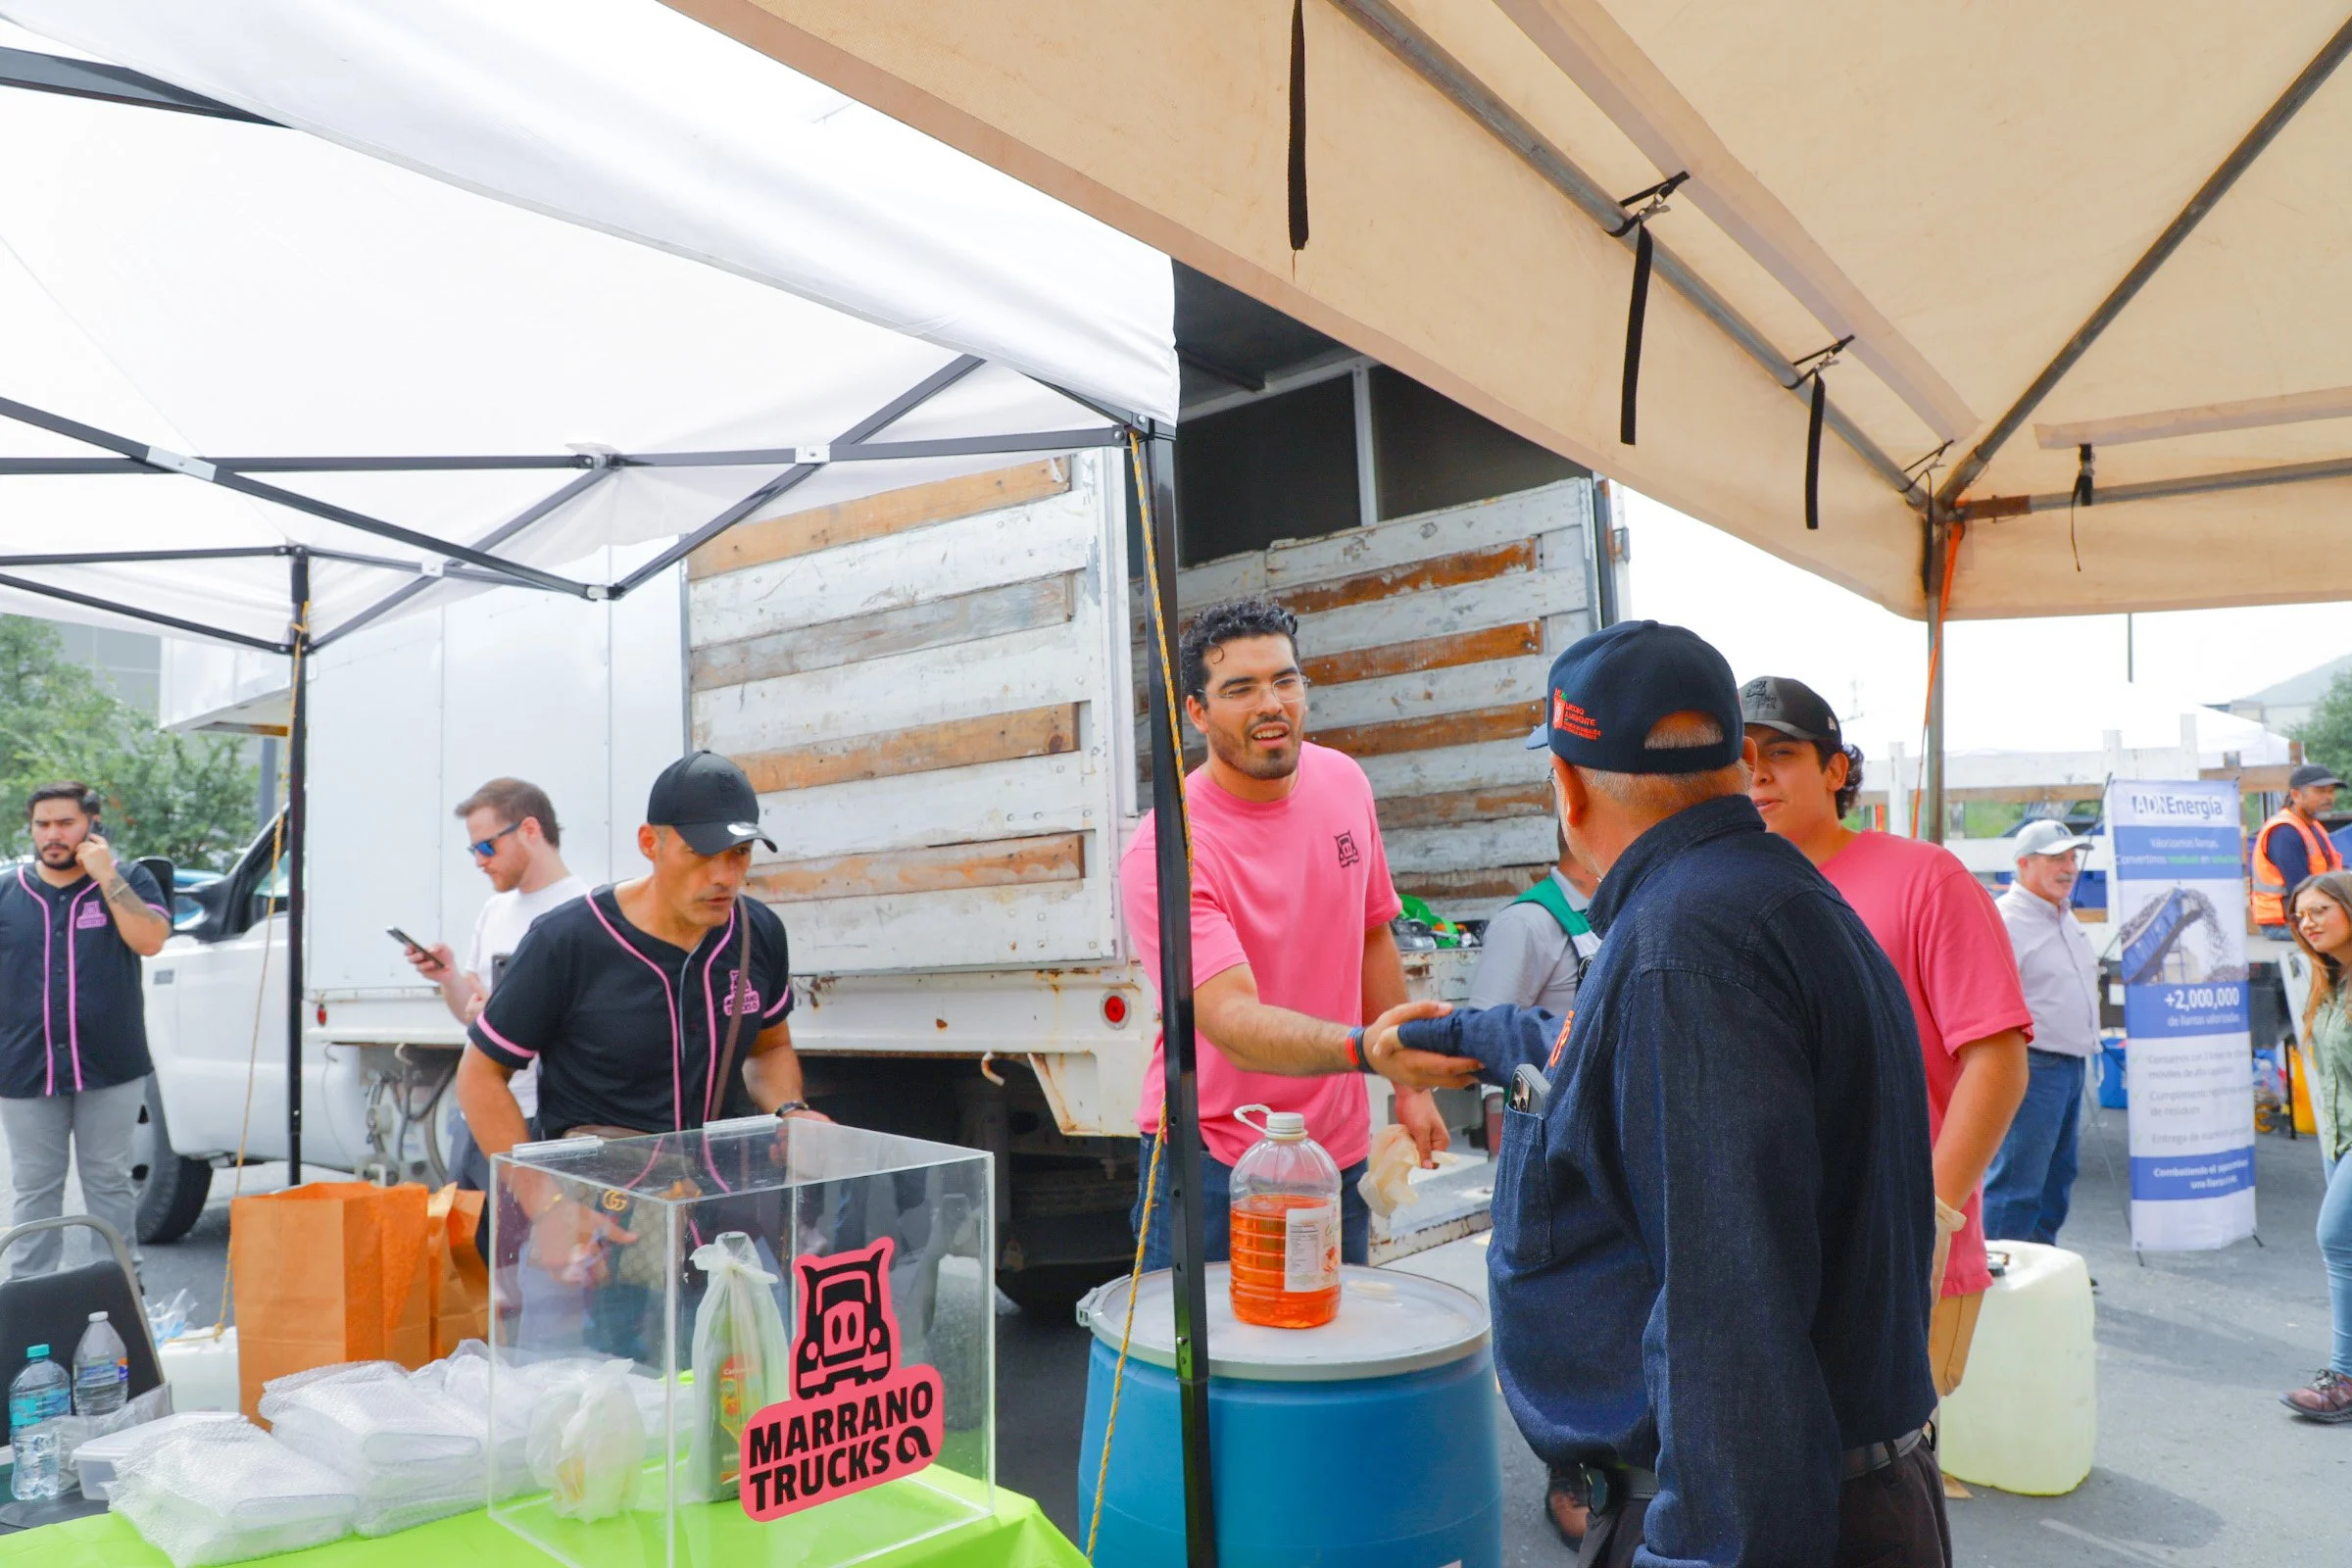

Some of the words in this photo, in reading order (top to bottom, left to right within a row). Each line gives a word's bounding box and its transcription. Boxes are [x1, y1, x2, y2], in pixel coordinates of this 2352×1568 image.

[2166, 795, 2224, 819] Energía
[2165, 987, 2240, 1011] +2,000,000
[750, 1381, 933, 1468] MARRANO
[750, 1435, 890, 1512] TRUCKS
